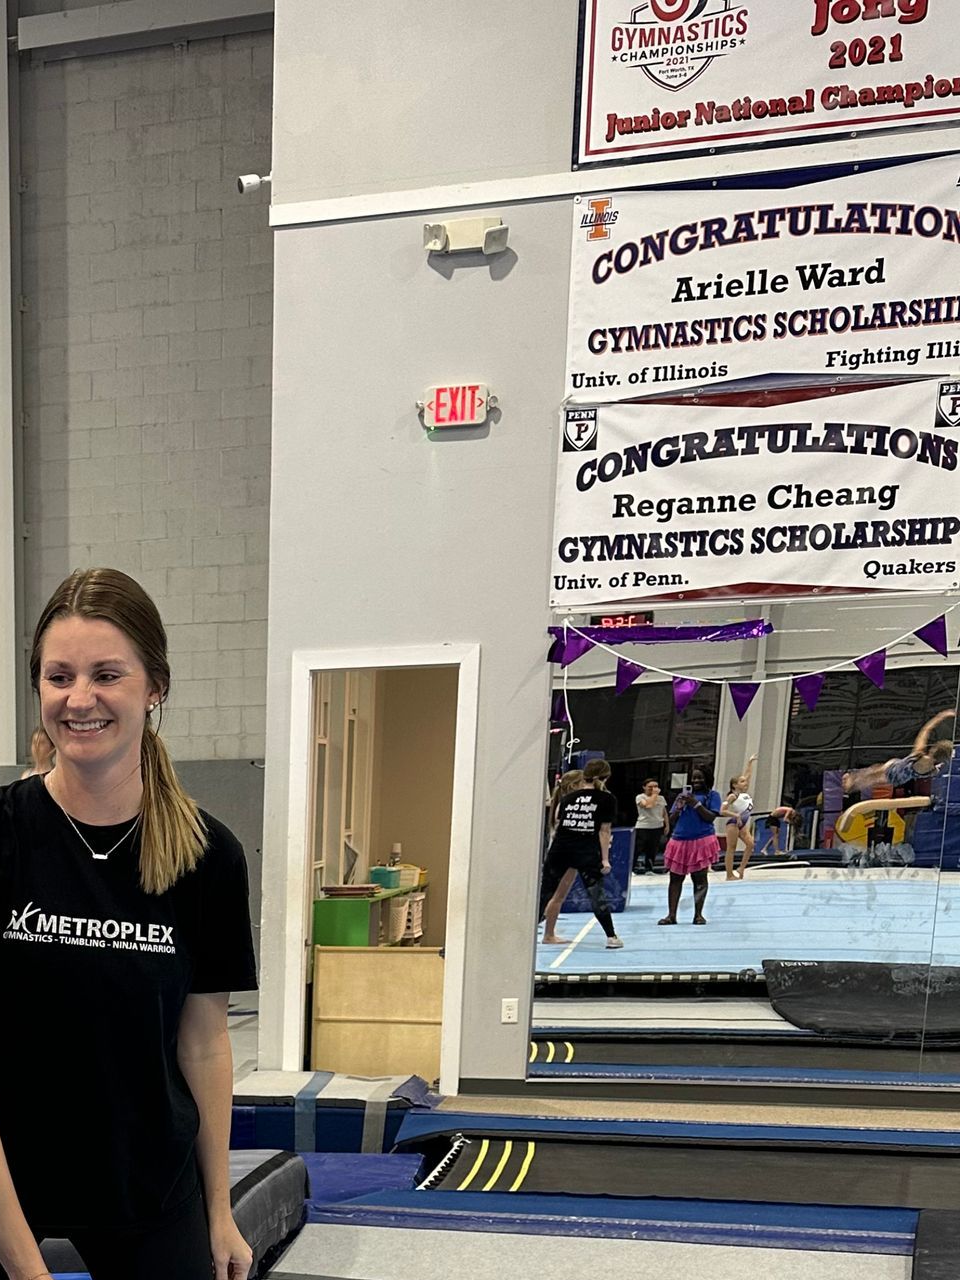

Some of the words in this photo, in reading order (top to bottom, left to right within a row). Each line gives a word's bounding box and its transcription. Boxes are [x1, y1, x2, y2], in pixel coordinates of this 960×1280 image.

[611, 9, 748, 52] GYMNASTICS
[811, 0, 929, 36] Jong
[620, 38, 737, 62] CHAMPIONSHIPS
[665, 56, 689, 66] 2021
[828, 33, 903, 69] 2021
[605, 106, 691, 142] Junior
[694, 89, 814, 126] National
[580, 210, 619, 226] ILLINOIS
[671, 268, 789, 304] Arielle
[795, 257, 886, 293] Ward
[587, 313, 766, 355] GYMNASTICS
[825, 345, 921, 368] Fighting
[571, 371, 622, 390] Univ.
[628, 366, 648, 385] of
[652, 361, 729, 382] Illinois
[434, 385, 480, 425] EXIT
[568, 410, 596, 420] PENN
[575, 422, 960, 492] CONGRATULATIONS
[612, 492, 757, 523] Reganne
[767, 482, 900, 511] Cheang
[558, 527, 744, 564] GYMNASTICS
[750, 516, 960, 555] SCHOLARSHIP
[553, 573, 602, 591] Univ.
[608, 571, 629, 588] of
[632, 571, 690, 588] Penn.
[862, 558, 956, 579] Quakers
[36, 914, 174, 944] METROPLEX
[60, 936, 106, 948] TUMBLING
[113, 940, 139, 951] NINJA
[140, 943, 176, 955] WARRIOR
